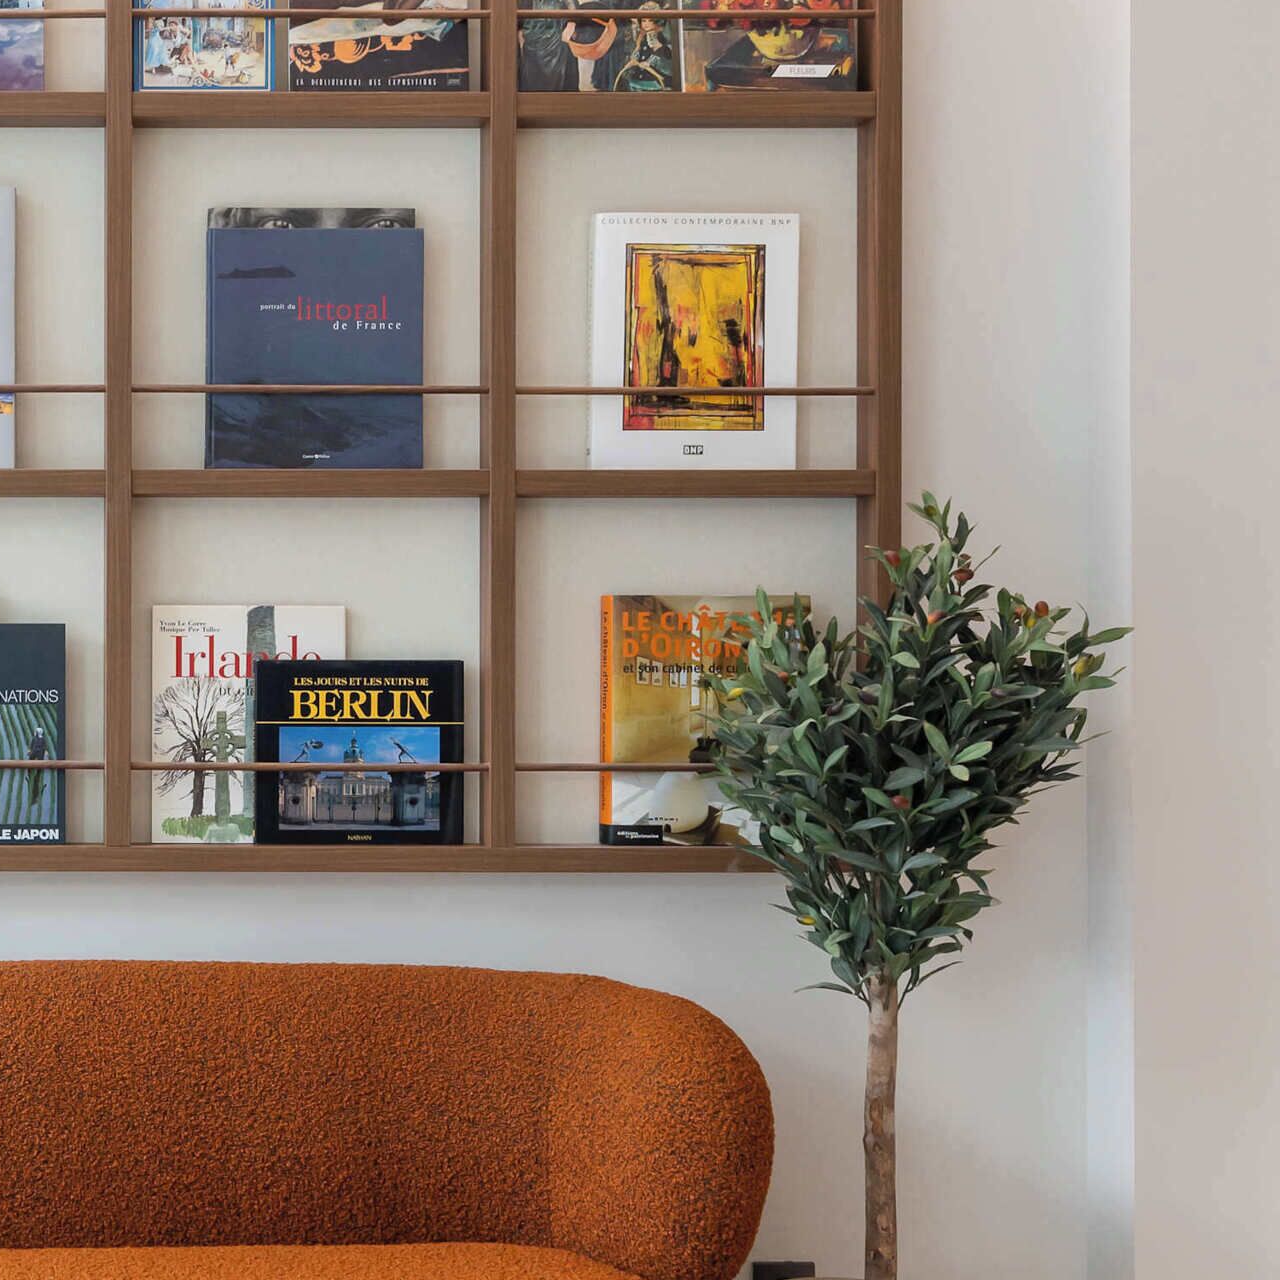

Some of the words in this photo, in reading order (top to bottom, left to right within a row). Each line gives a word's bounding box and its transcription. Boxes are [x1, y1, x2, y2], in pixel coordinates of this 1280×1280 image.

[260, 303, 285, 311] portrait
[297, 295, 387, 321] littoral
[333, 320, 348, 330] de
[356, 320, 402, 330] France
[623, 611, 650, 631] LE
[624, 664, 634, 672] et
[639, 664, 658, 672] son
[663, 663, 704, 673] cabinet
[709, 663, 720, 673] de
[294, 677, 313, 686] LES
[314, 677, 347, 686] JOURS
[349, 677, 362, 686] ET
[363, 677, 382, 686] LES
[384, 677, 414, 686] NUITS
[416, 677, 429, 686] DE
[289, 689, 434, 721] BERLIN
[14, 829, 59, 840] JAPON
